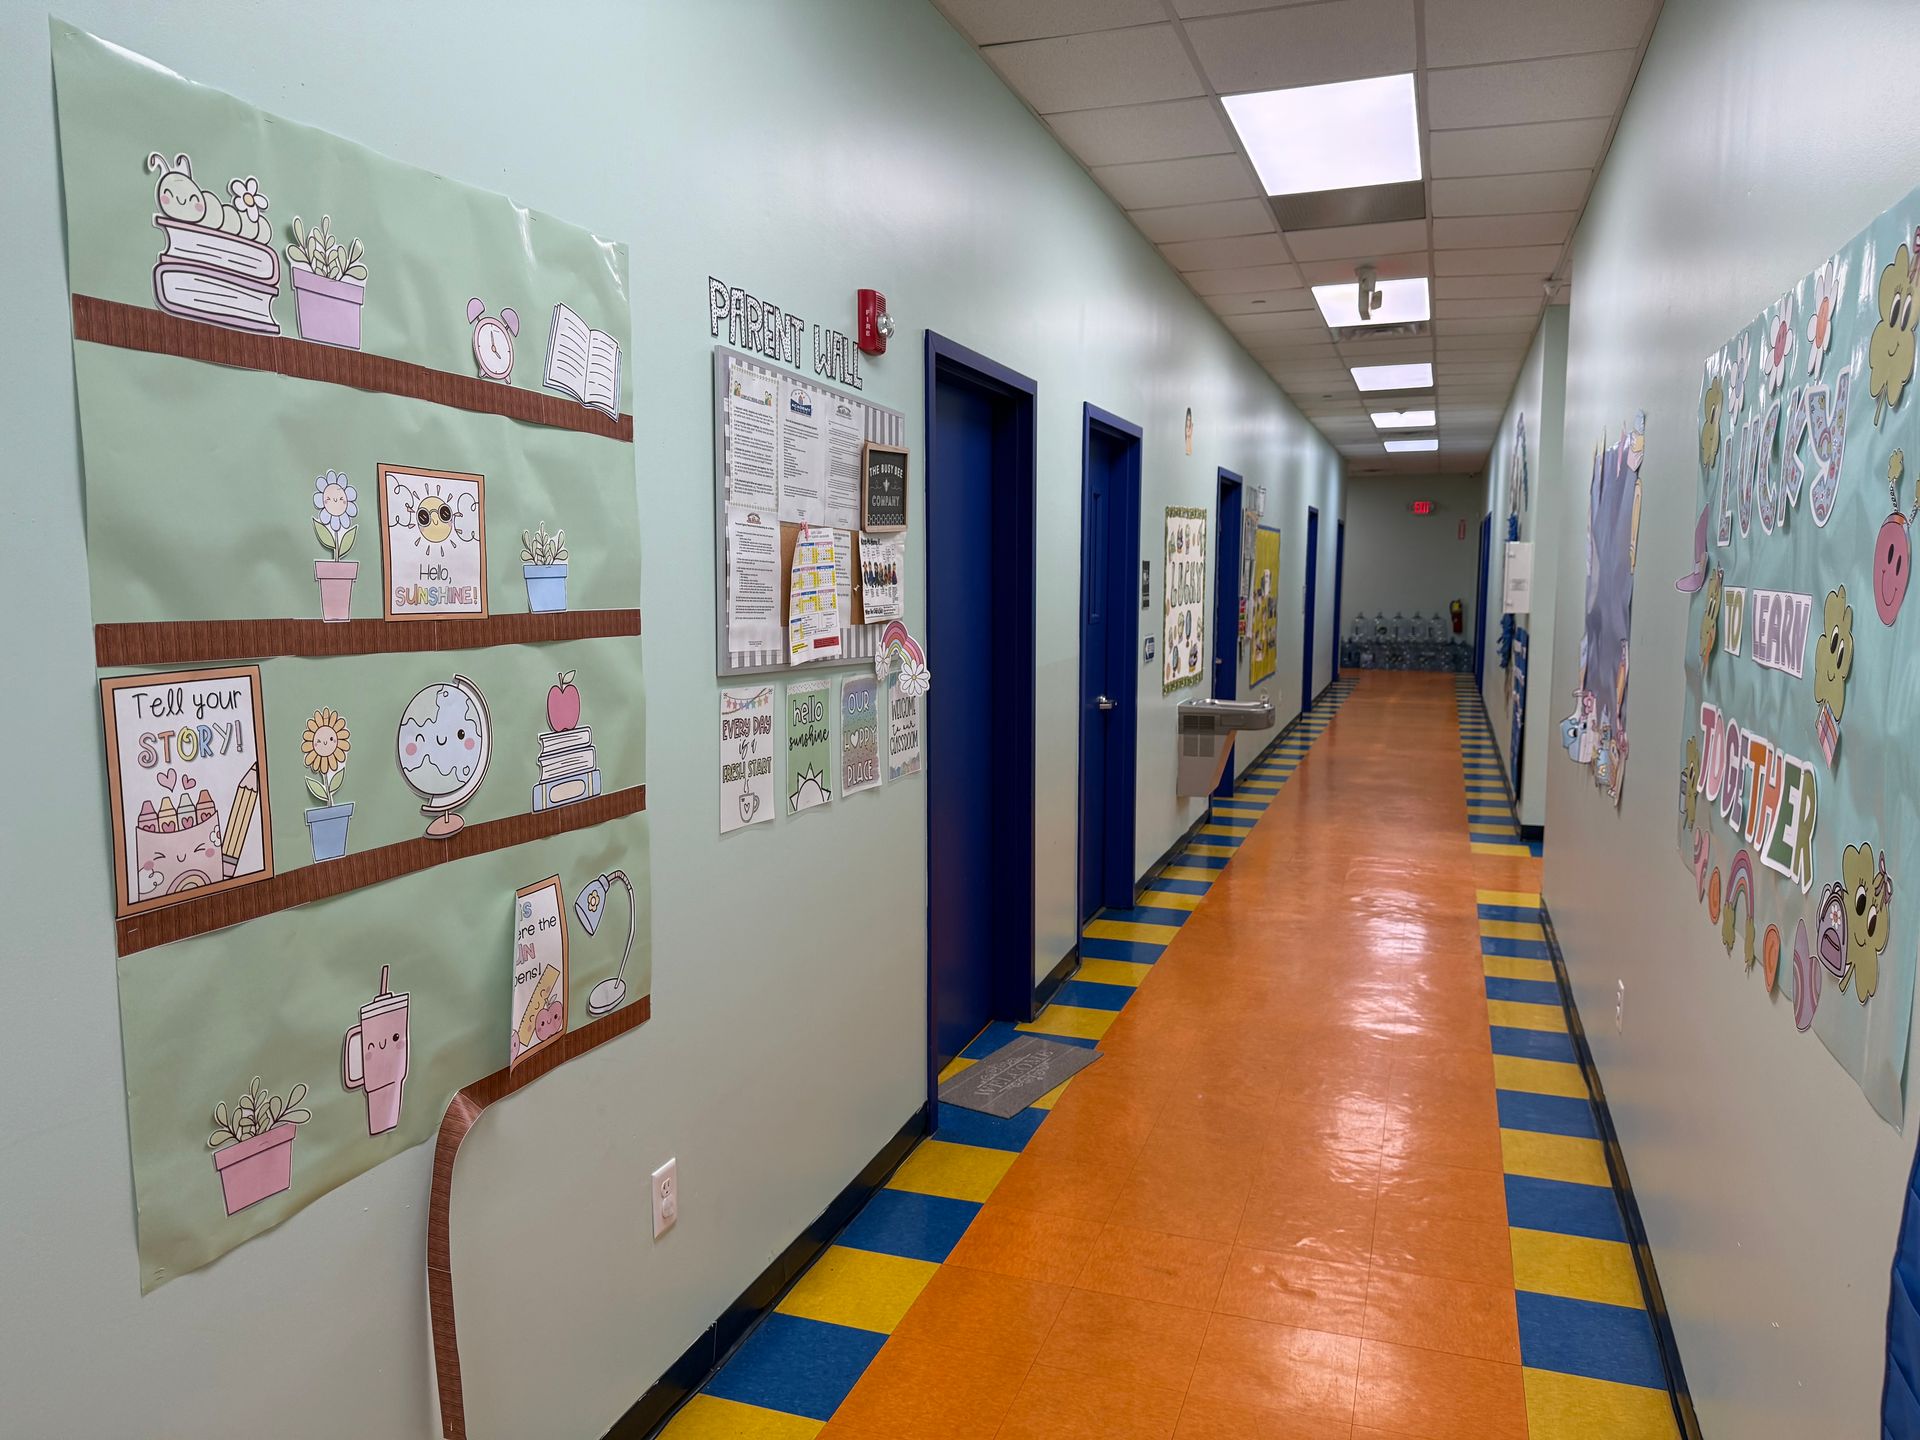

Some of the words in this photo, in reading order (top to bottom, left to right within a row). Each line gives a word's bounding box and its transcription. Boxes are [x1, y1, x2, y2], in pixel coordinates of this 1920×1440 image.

[708, 276, 804, 369] PARENT
[813, 324, 863, 391] WALL
[1716, 366, 1851, 548] LUCKY
[869, 464, 880, 477] THE
[881, 463, 894, 474] BUSY
[894, 465, 904, 479] BEE
[871, 495, 900, 507] COMPANY
[1414, 501, 1431, 514] EXIT
[419, 564, 452, 585] Hello,
[395, 584, 479, 607] SUNSHINE!
[1725, 590, 1745, 652] TO
[1752, 590, 1811, 675] LEARN
[131, 687, 183, 719] Tell
[193, 688, 242, 720] your
[793, 695, 824, 726] hello
[848, 690, 870, 714] OUR
[891, 695, 916, 721] WELCOME
[722, 717, 751, 741] EVERY
[752, 715, 772, 736] DAY
[789, 725, 830, 751] sunshine
[137, 719, 244, 768] STORY!
[722, 761, 747, 784] FRESH
[747, 756, 772, 778] START
[847, 758, 873, 788] PLACE
[1697, 702, 1818, 895] TOGETHER
[538, 915, 557, 932] the
[974, 1049, 1056, 1096] WELCOME
